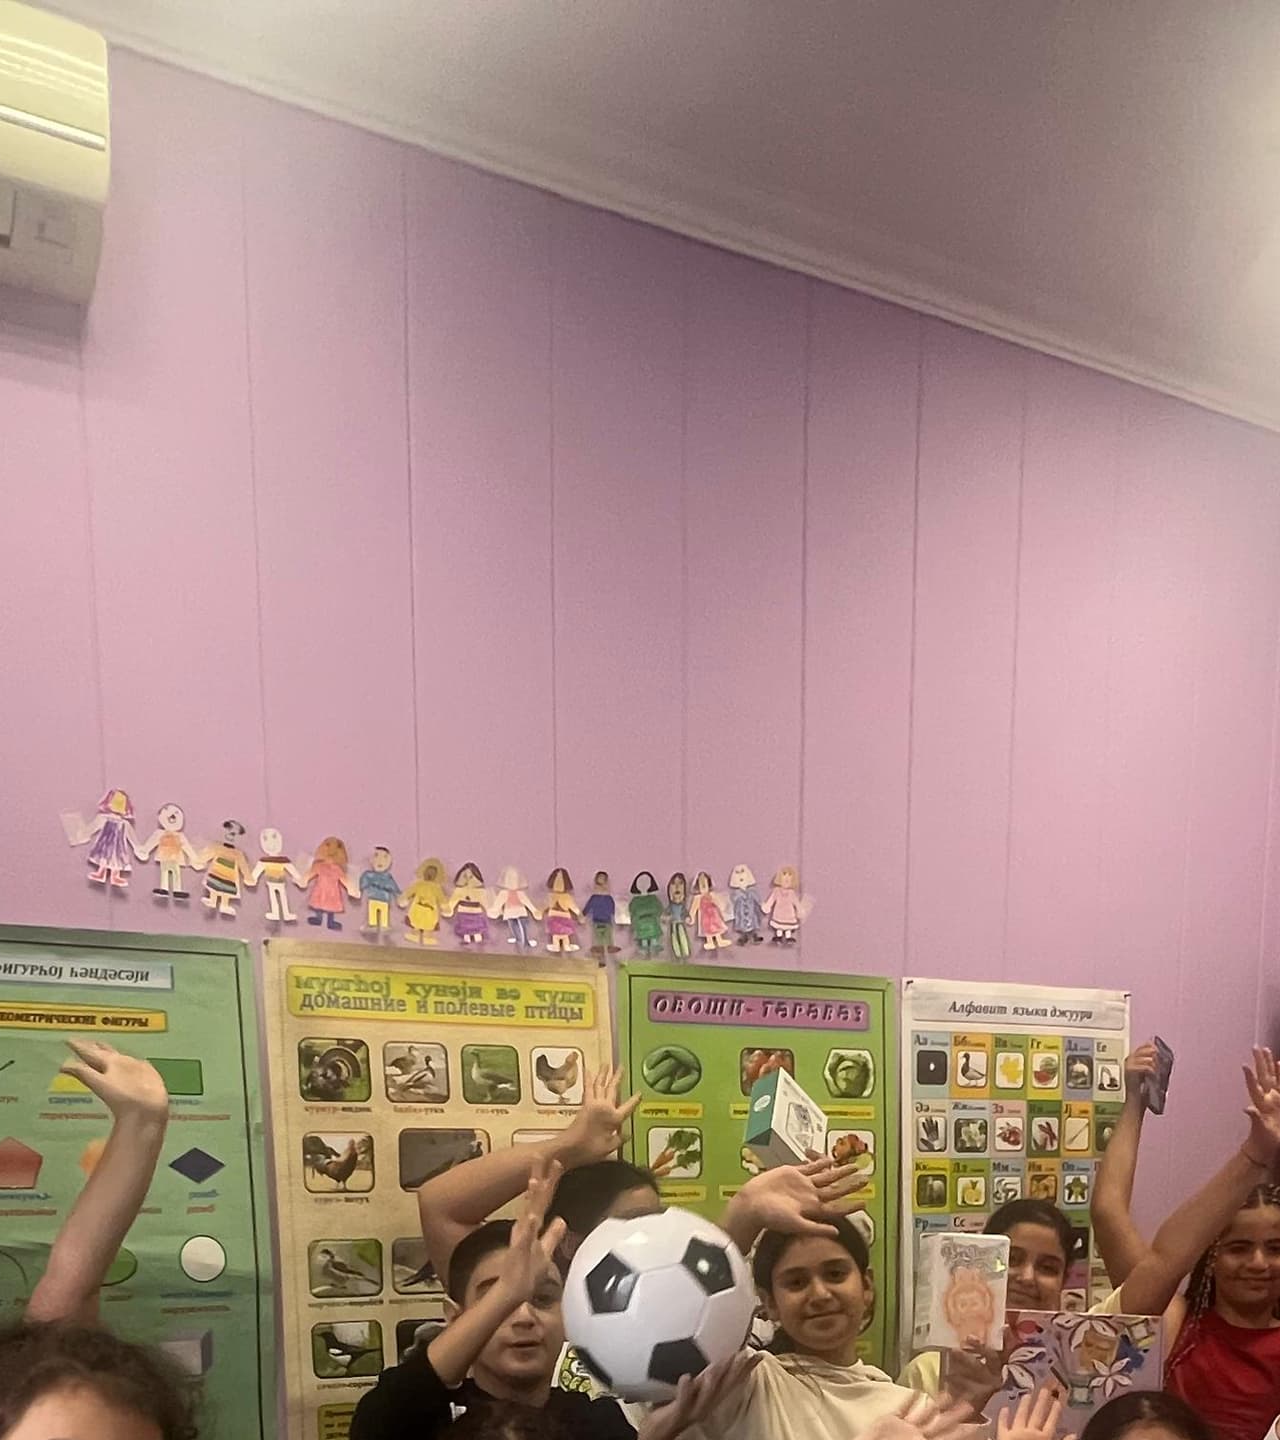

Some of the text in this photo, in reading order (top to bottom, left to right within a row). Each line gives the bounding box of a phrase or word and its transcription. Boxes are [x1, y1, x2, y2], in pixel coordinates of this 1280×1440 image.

[948, 1001, 1008, 1020] Алфавит
[1012, 1007, 1048, 1017] языка
[101, 1014, 150, 1028] ФИГУРЫ
